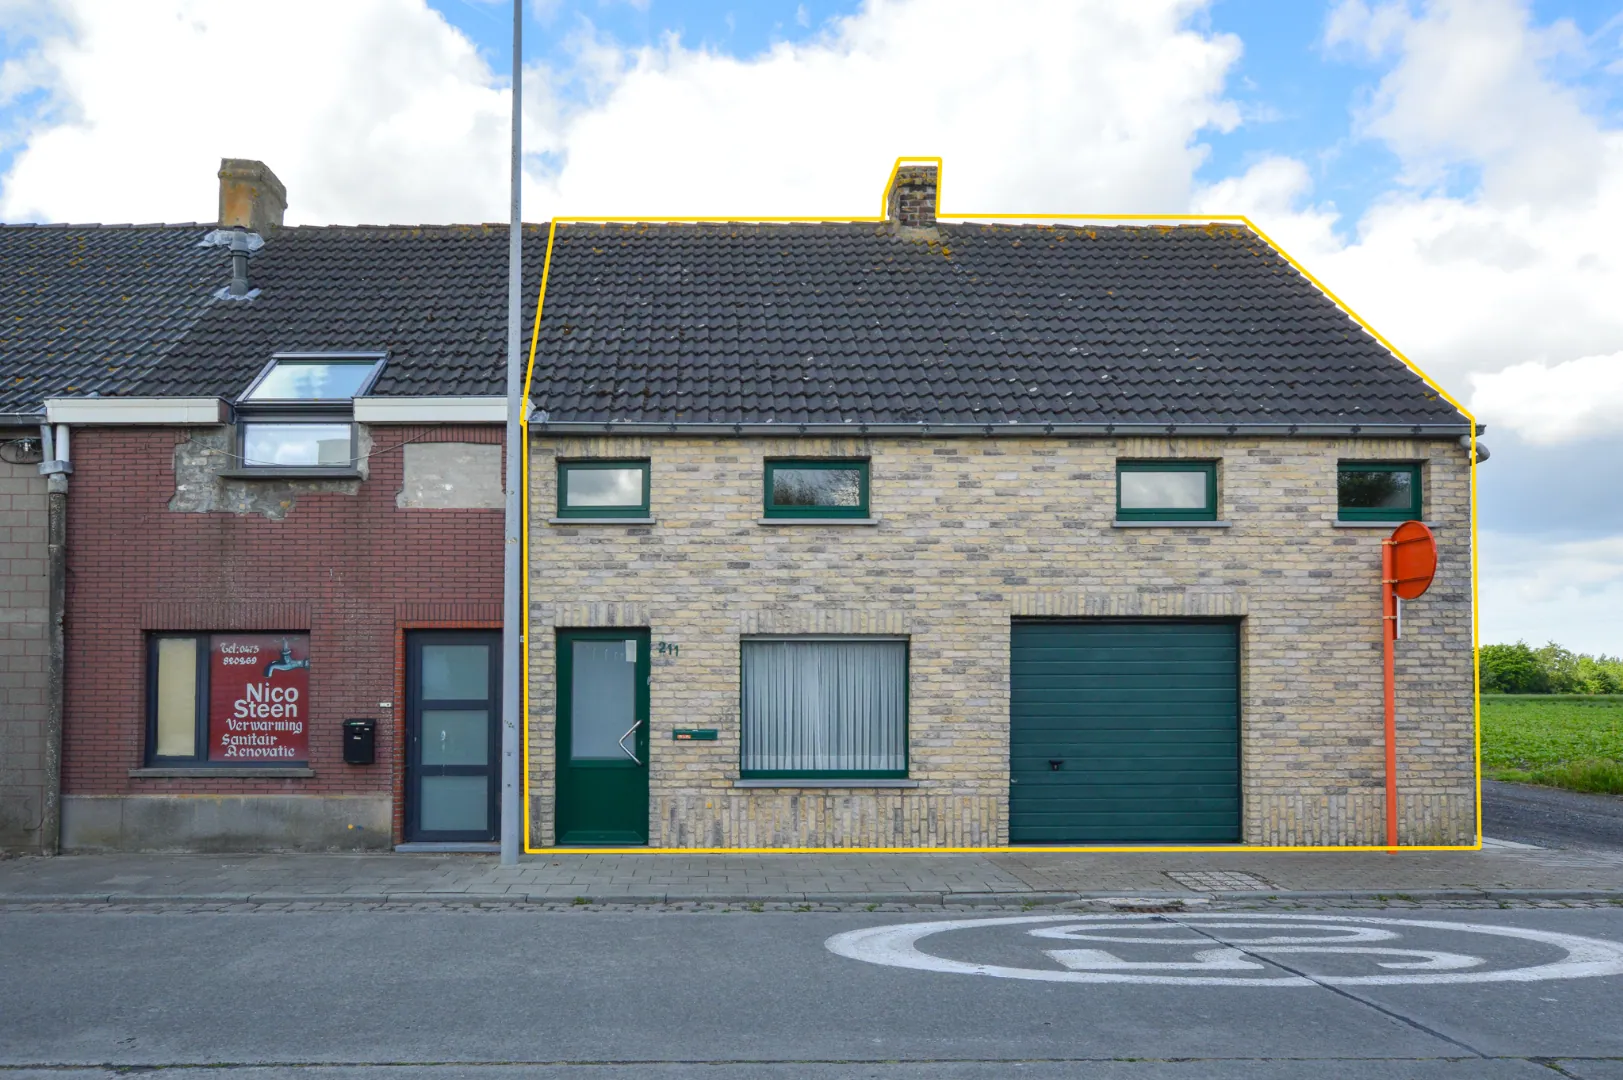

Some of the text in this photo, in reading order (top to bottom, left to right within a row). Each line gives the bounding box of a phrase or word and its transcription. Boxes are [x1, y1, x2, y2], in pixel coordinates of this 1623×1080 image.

[658, 641, 679, 656] 211
[246, 682, 299, 702] Nico
[234, 699, 298, 718] Steen
[226, 718, 303, 735] Verwarming
[221, 733, 278, 746] Sanitair
[224, 744, 295, 757] Renovatie
[1028, 922, 1487, 970] 50
